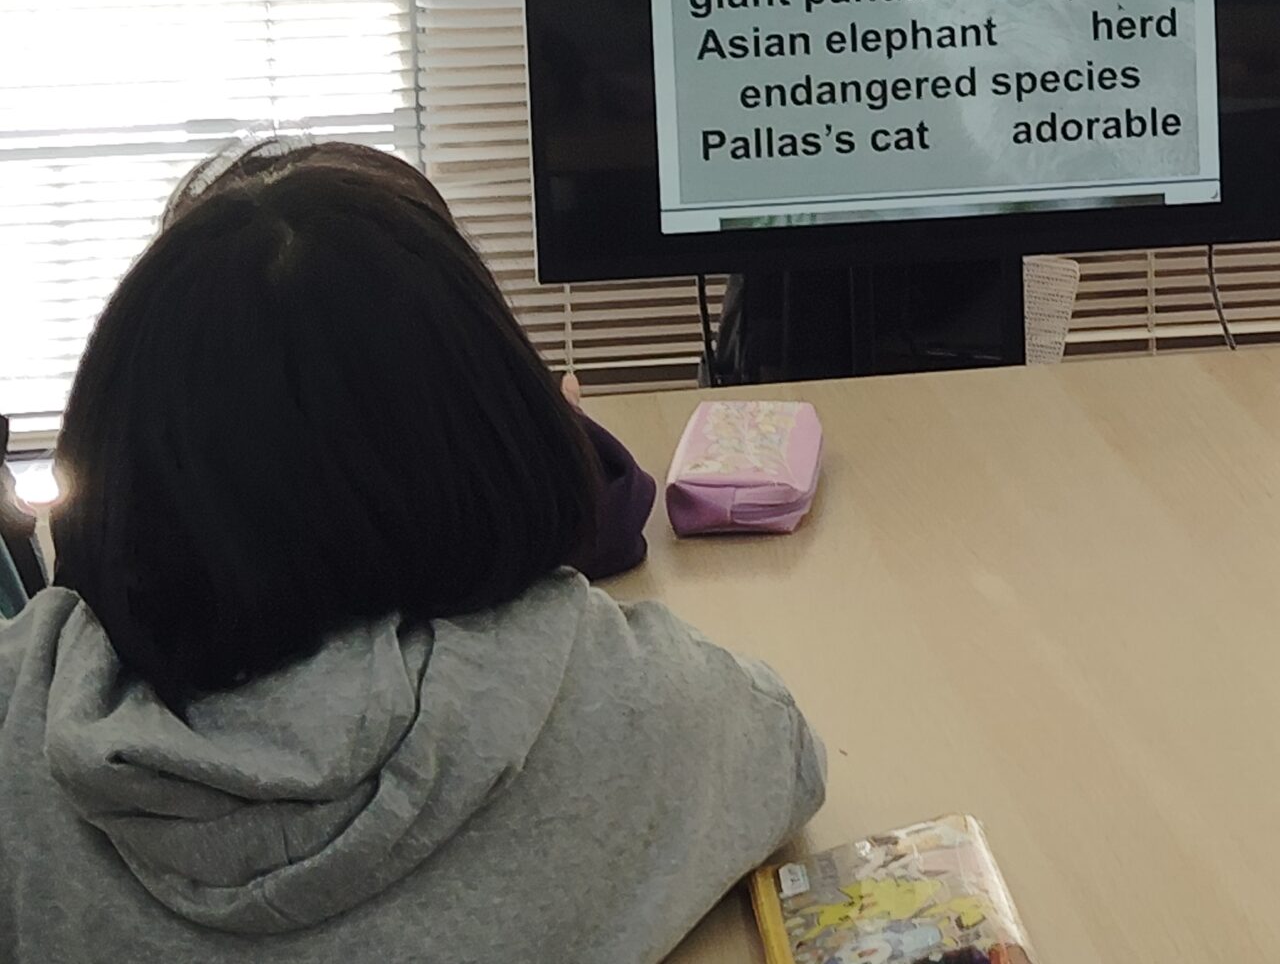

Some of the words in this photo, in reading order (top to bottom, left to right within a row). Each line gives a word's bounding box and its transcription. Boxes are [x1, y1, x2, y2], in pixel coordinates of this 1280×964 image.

[696, 26, 811, 61] Asian
[825, 16, 998, 60] elephant
[1091, 8, 1177, 41] herd
[739, 67, 977, 111] endangered
[991, 61, 1141, 103] species
[701, 123, 856, 162] Pallas’s
[870, 120, 930, 153] cat
[1012, 107, 1182, 145] adorable
